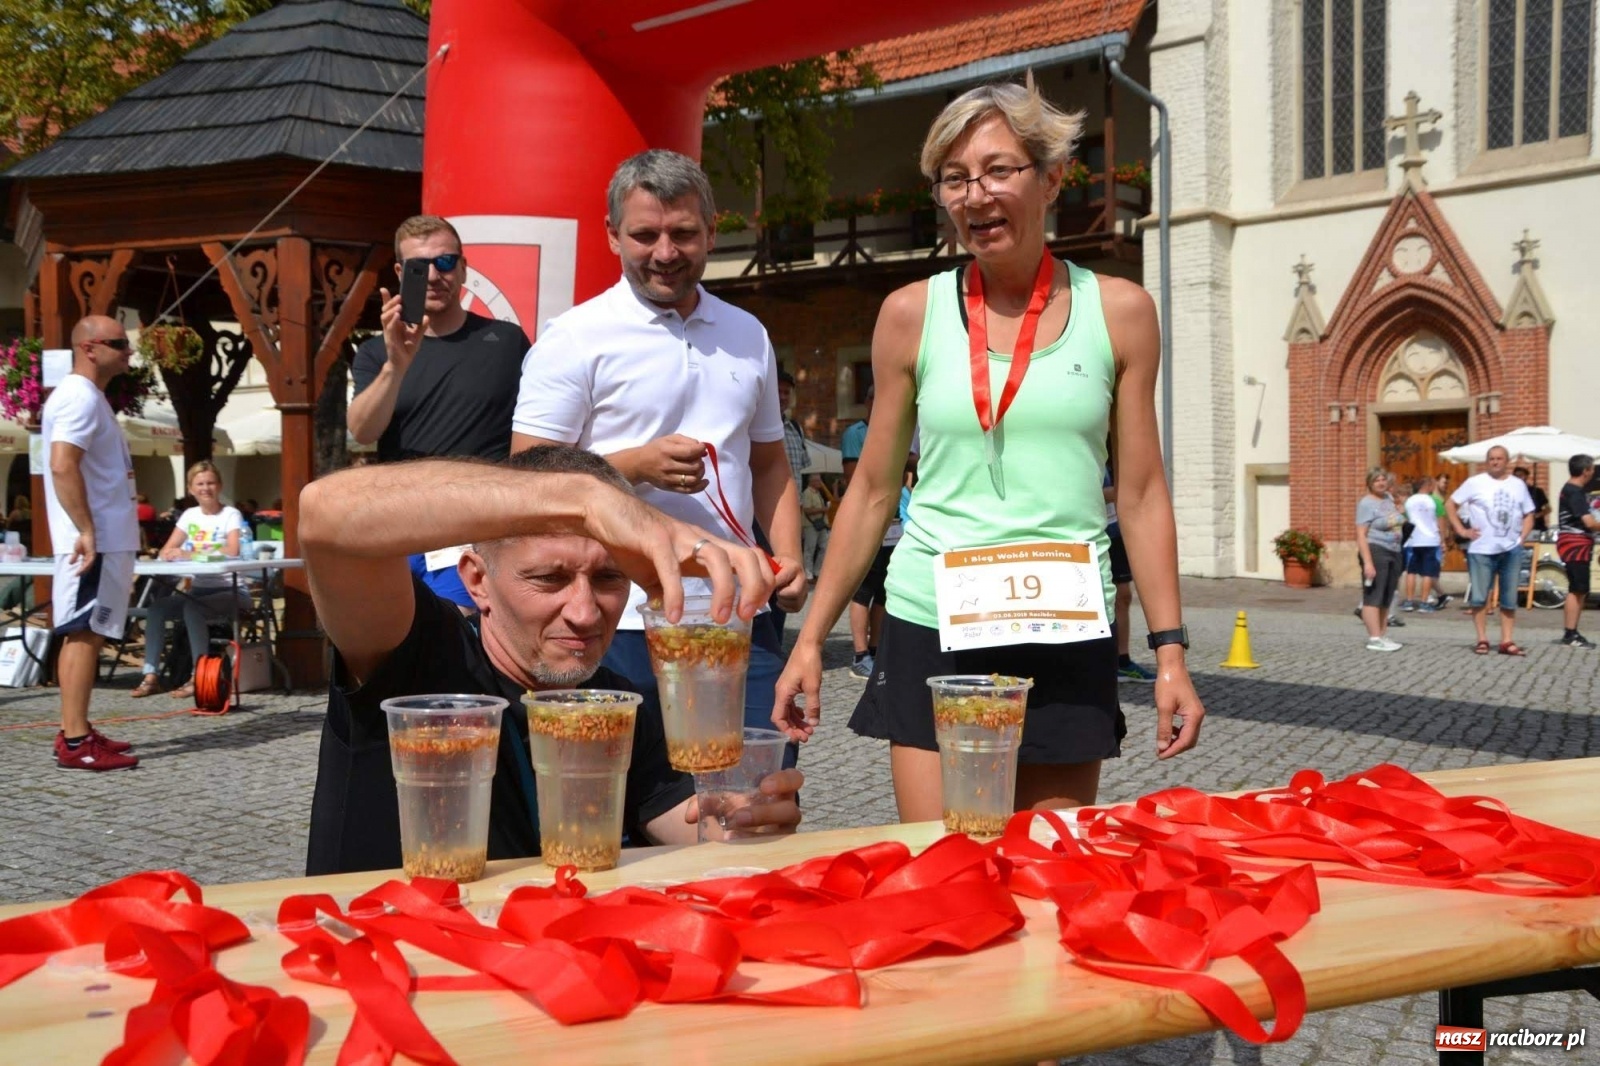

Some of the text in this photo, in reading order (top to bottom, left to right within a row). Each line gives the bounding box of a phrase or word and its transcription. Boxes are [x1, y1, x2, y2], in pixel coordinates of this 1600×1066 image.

[971, 554, 994, 563] Bieg
[1032, 549, 1072, 558] Komina
[1003, 574, 1042, 600] 19
